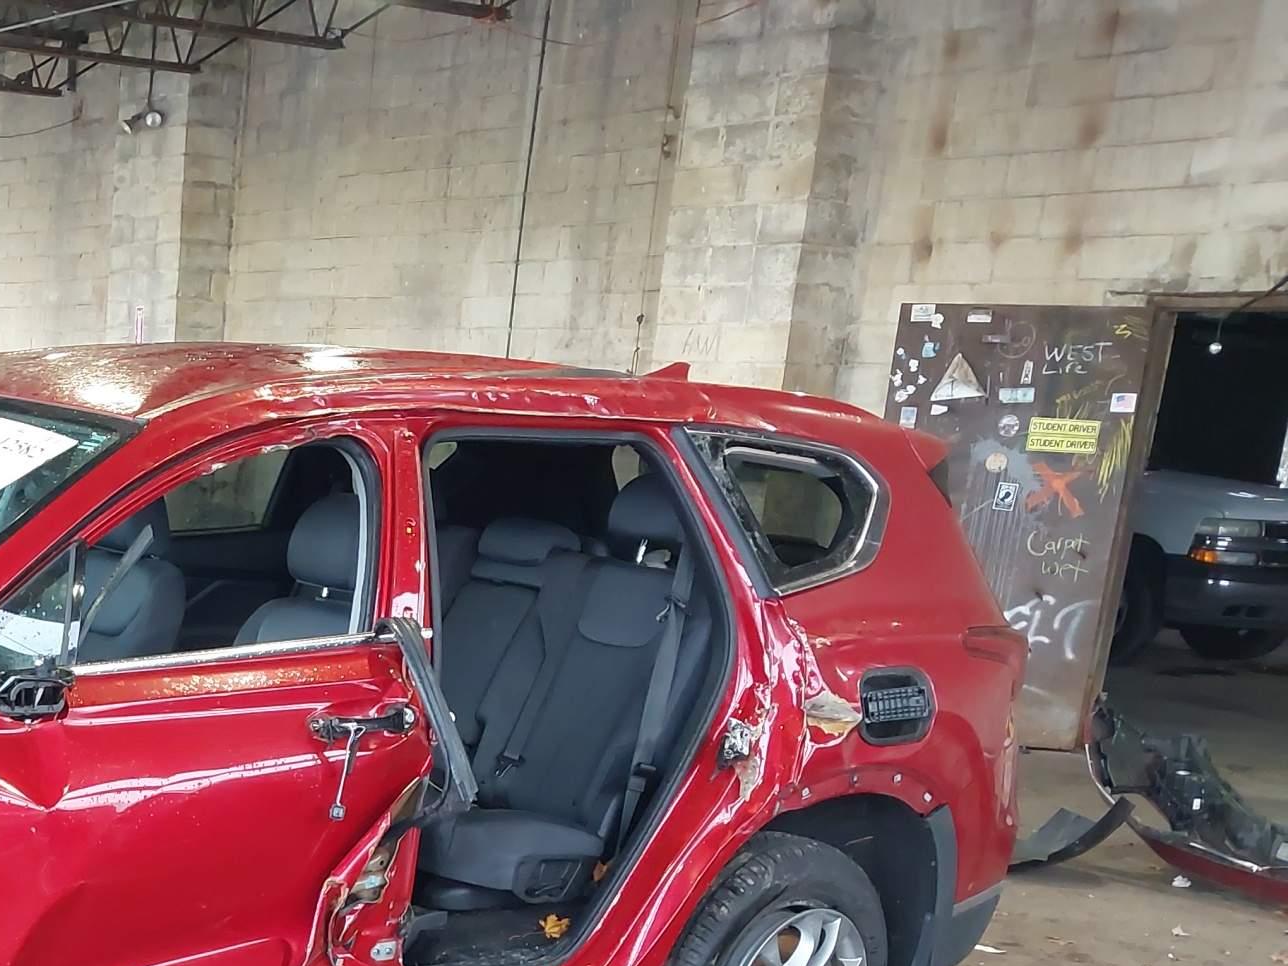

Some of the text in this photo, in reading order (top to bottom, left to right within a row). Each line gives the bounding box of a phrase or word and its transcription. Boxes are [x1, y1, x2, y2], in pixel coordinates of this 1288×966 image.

[1044, 342, 1113, 363] WEST
[1032, 421, 1068, 432] STUDENT
[1068, 424, 1098, 434] DRIVER
[1029, 438, 1096, 450] STUDENT DRIVER
